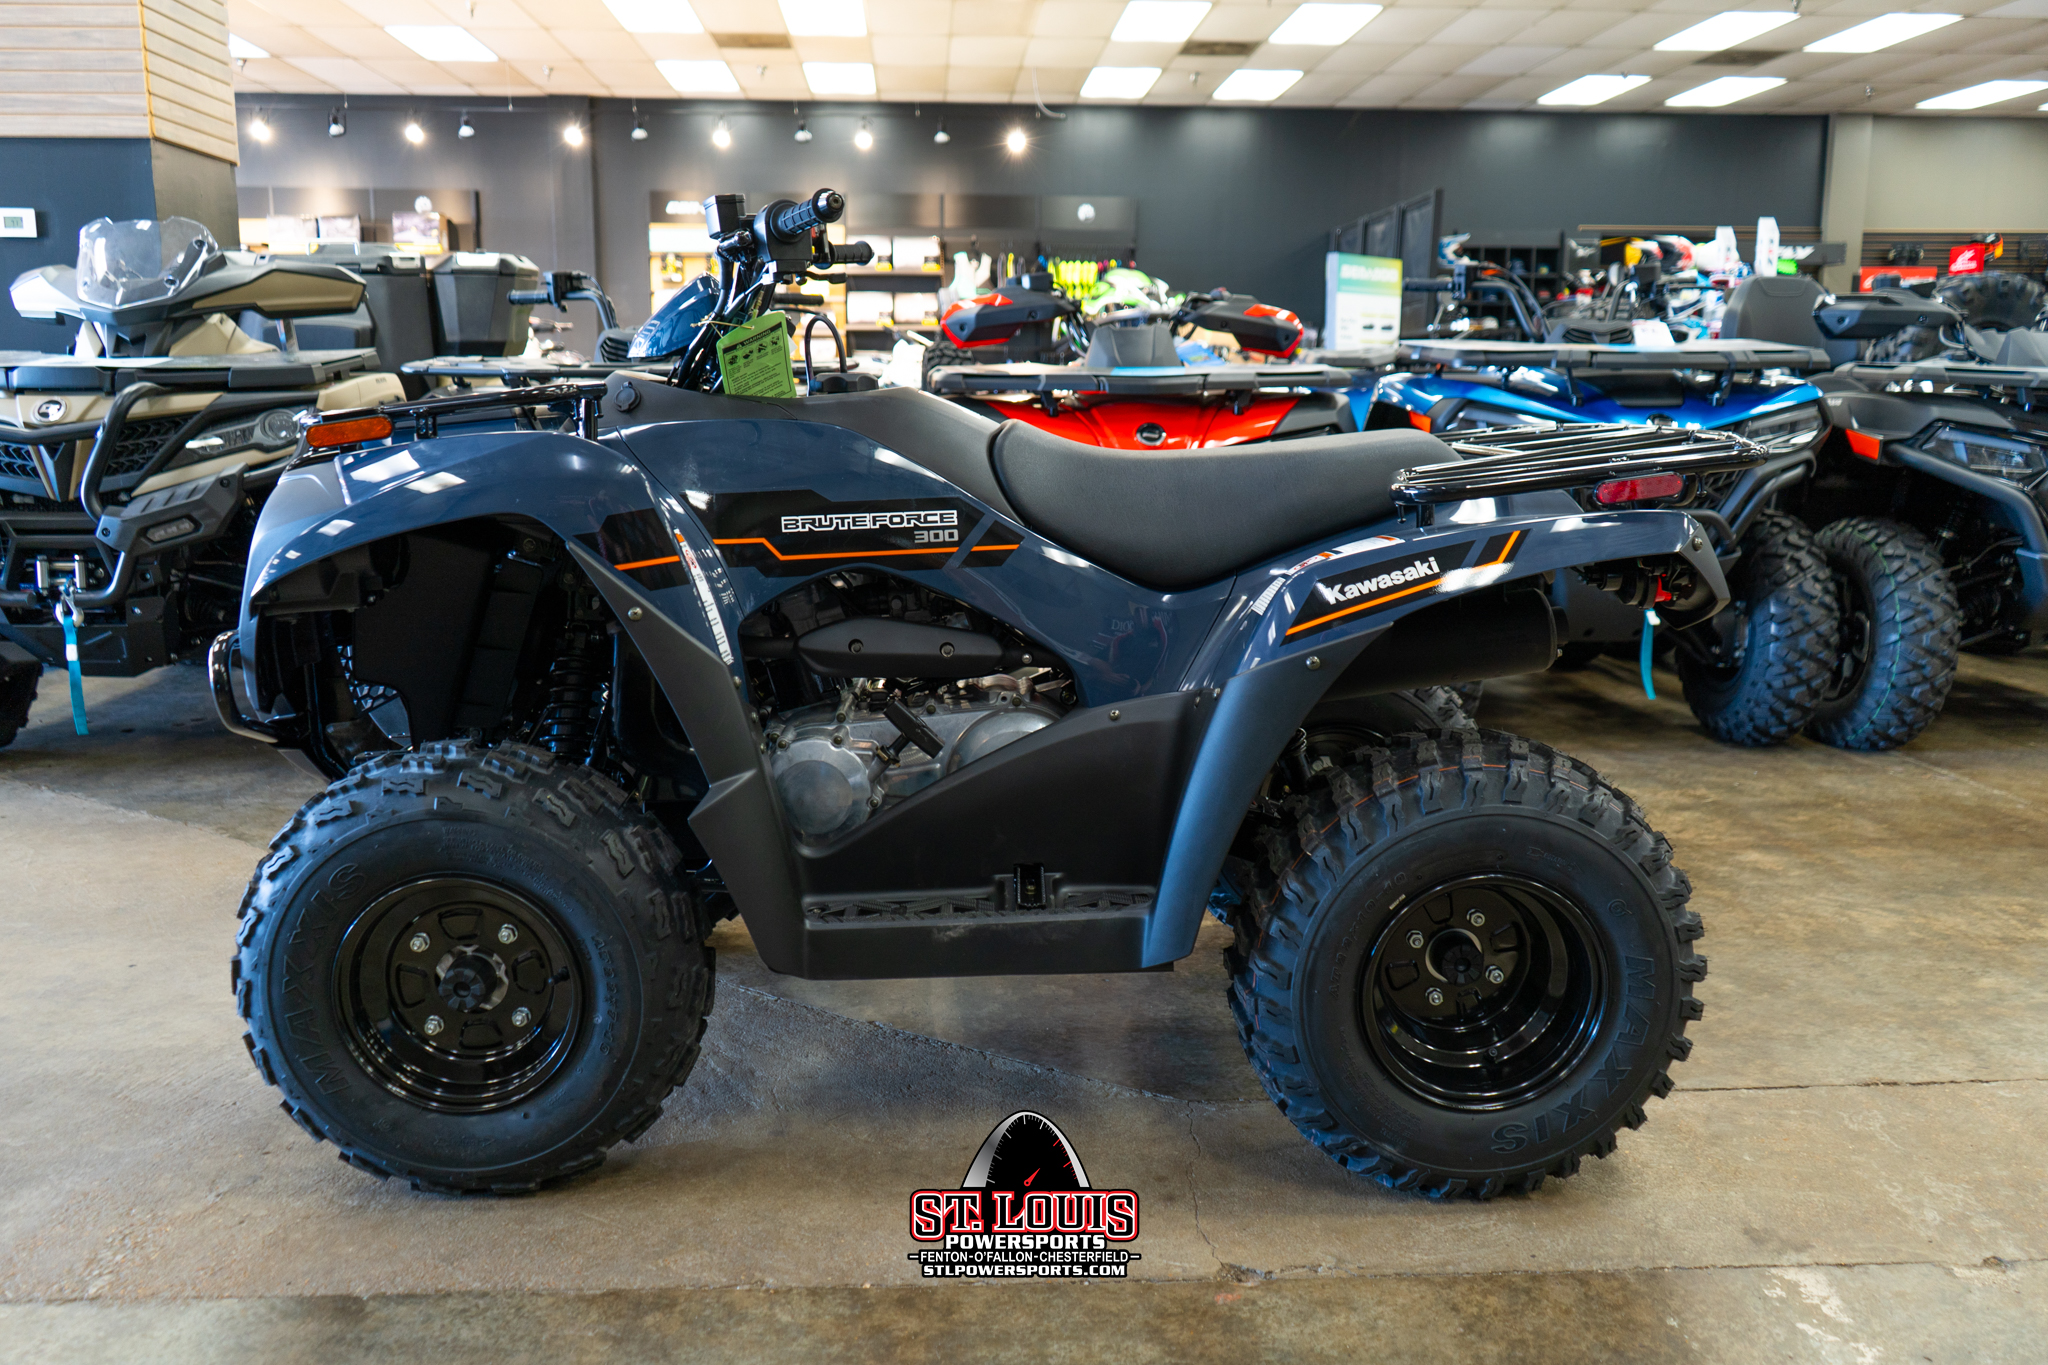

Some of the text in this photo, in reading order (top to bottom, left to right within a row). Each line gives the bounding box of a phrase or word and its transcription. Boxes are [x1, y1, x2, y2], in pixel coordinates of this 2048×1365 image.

[781, 510, 958, 532] BRUTE FORCE
[913, 529, 959, 543] 300
[1328, 556, 1440, 605] Kawasaki
[282, 862, 367, 1095] MAXXIS
[1491, 955, 1656, 1154] MAXXIS
